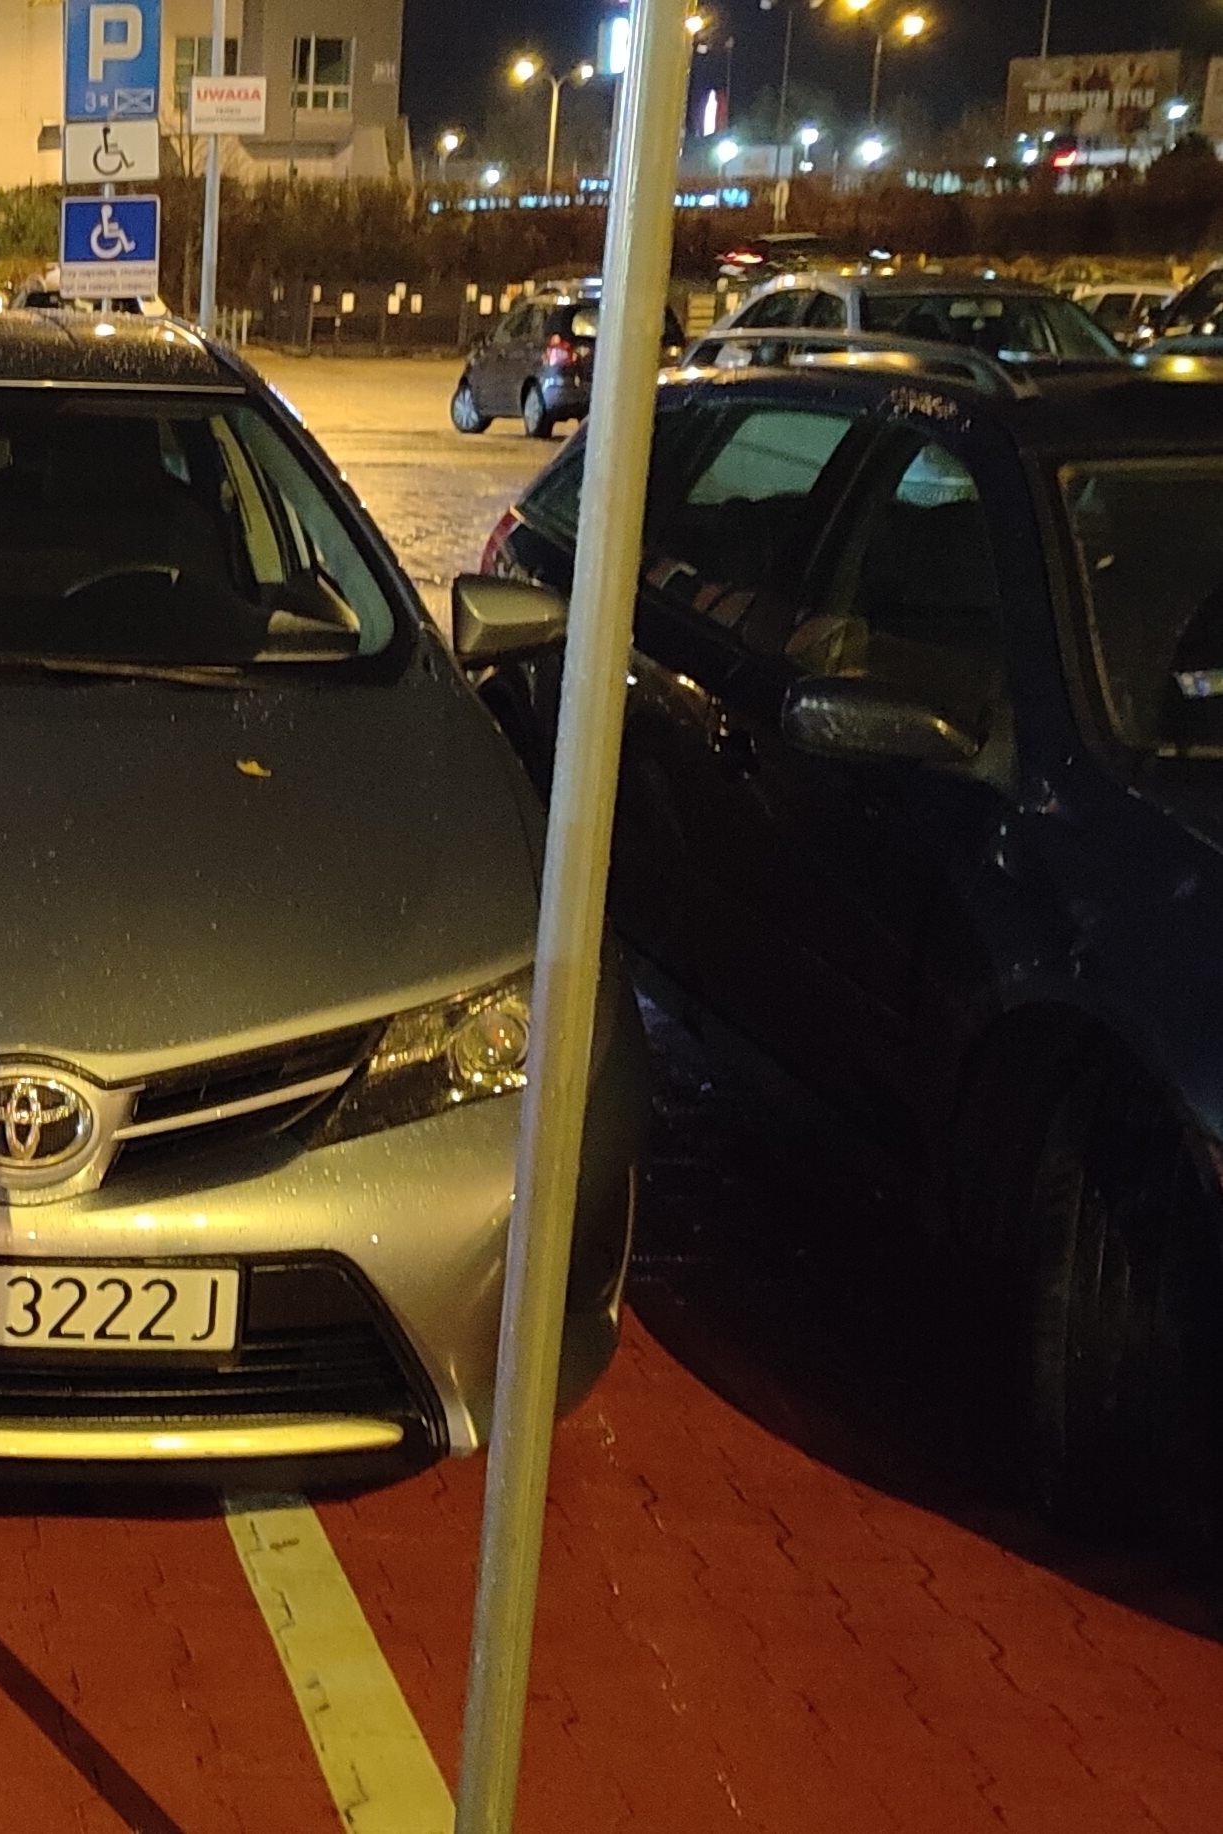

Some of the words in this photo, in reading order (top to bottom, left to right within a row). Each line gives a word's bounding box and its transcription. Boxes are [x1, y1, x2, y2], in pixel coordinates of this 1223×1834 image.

[88, 4, 143, 83] P
[196, 88, 262, 101] UWAGA
[4, 1276, 219, 1343] 3222J
